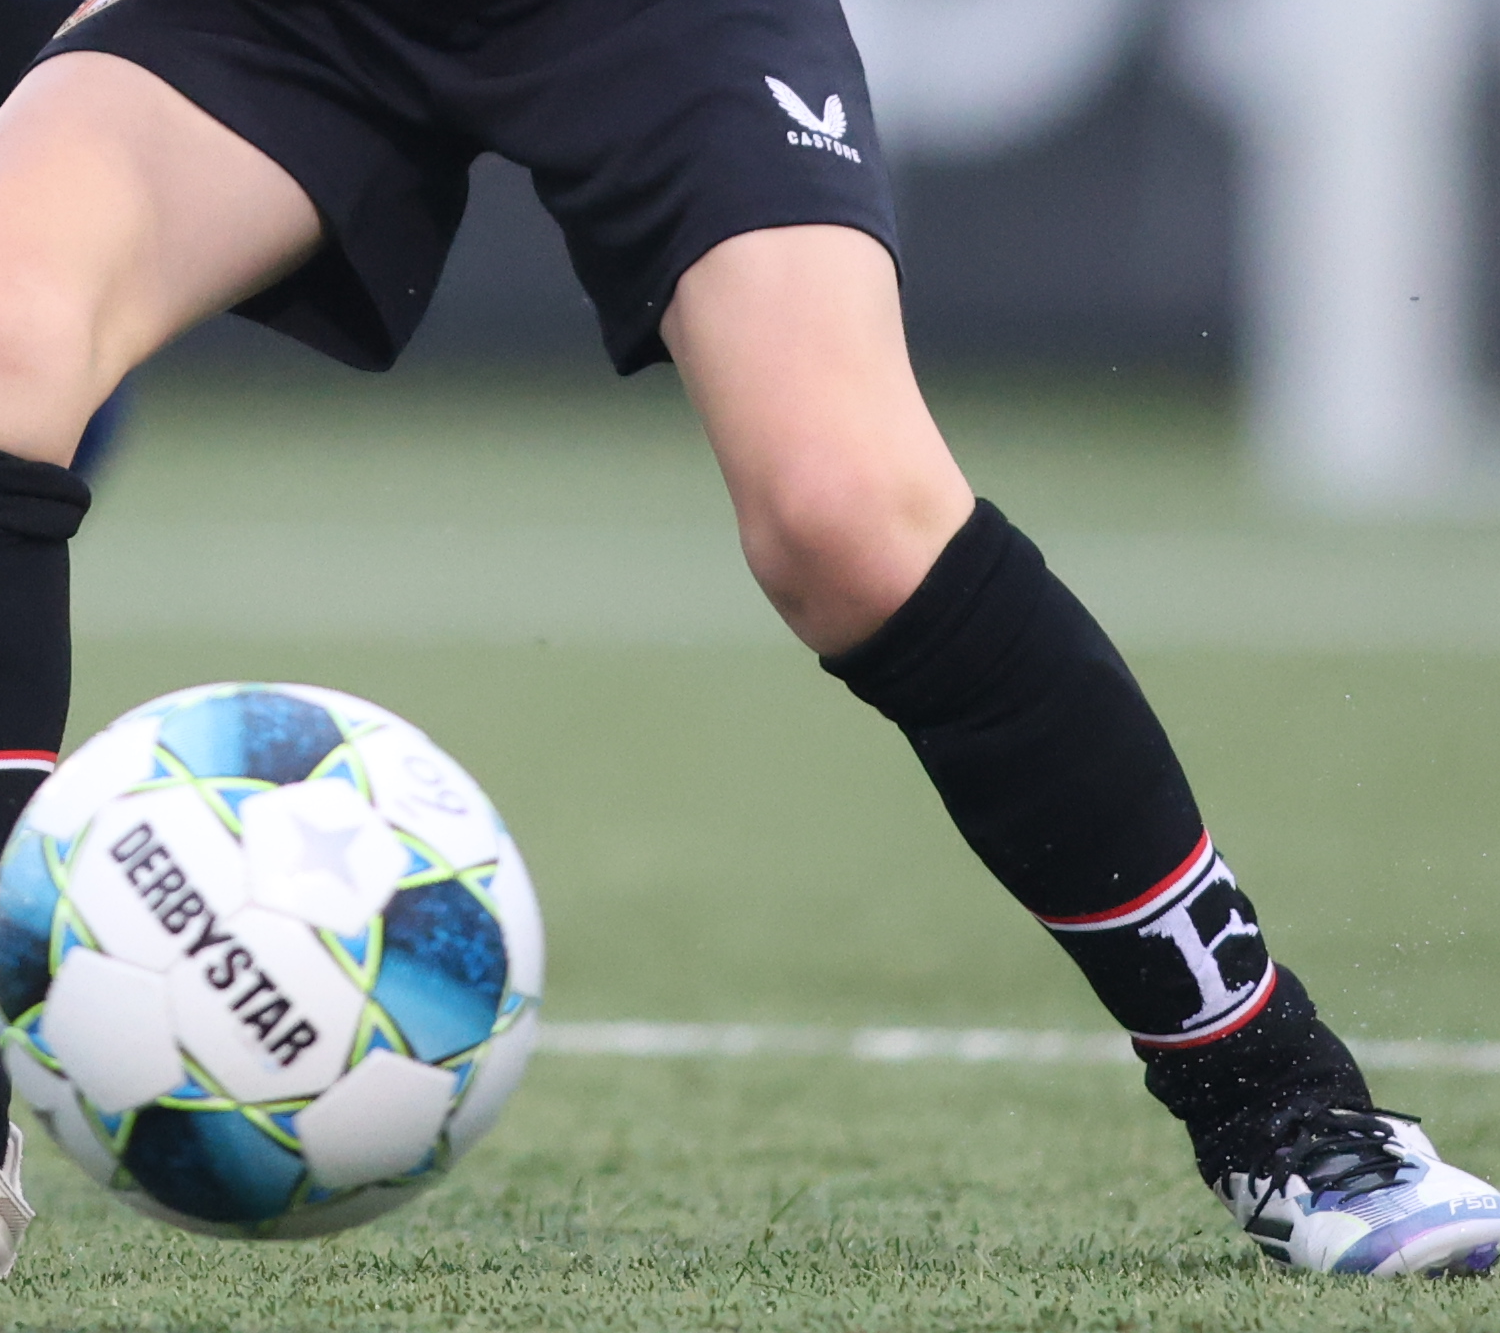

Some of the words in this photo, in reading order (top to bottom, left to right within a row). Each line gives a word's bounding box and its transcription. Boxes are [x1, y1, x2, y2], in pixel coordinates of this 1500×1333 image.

[786, 130, 862, 164] CASTORE
[108, 820, 318, 1069] DERBYSTAR
[1448, 1195, 1498, 1216] F50
